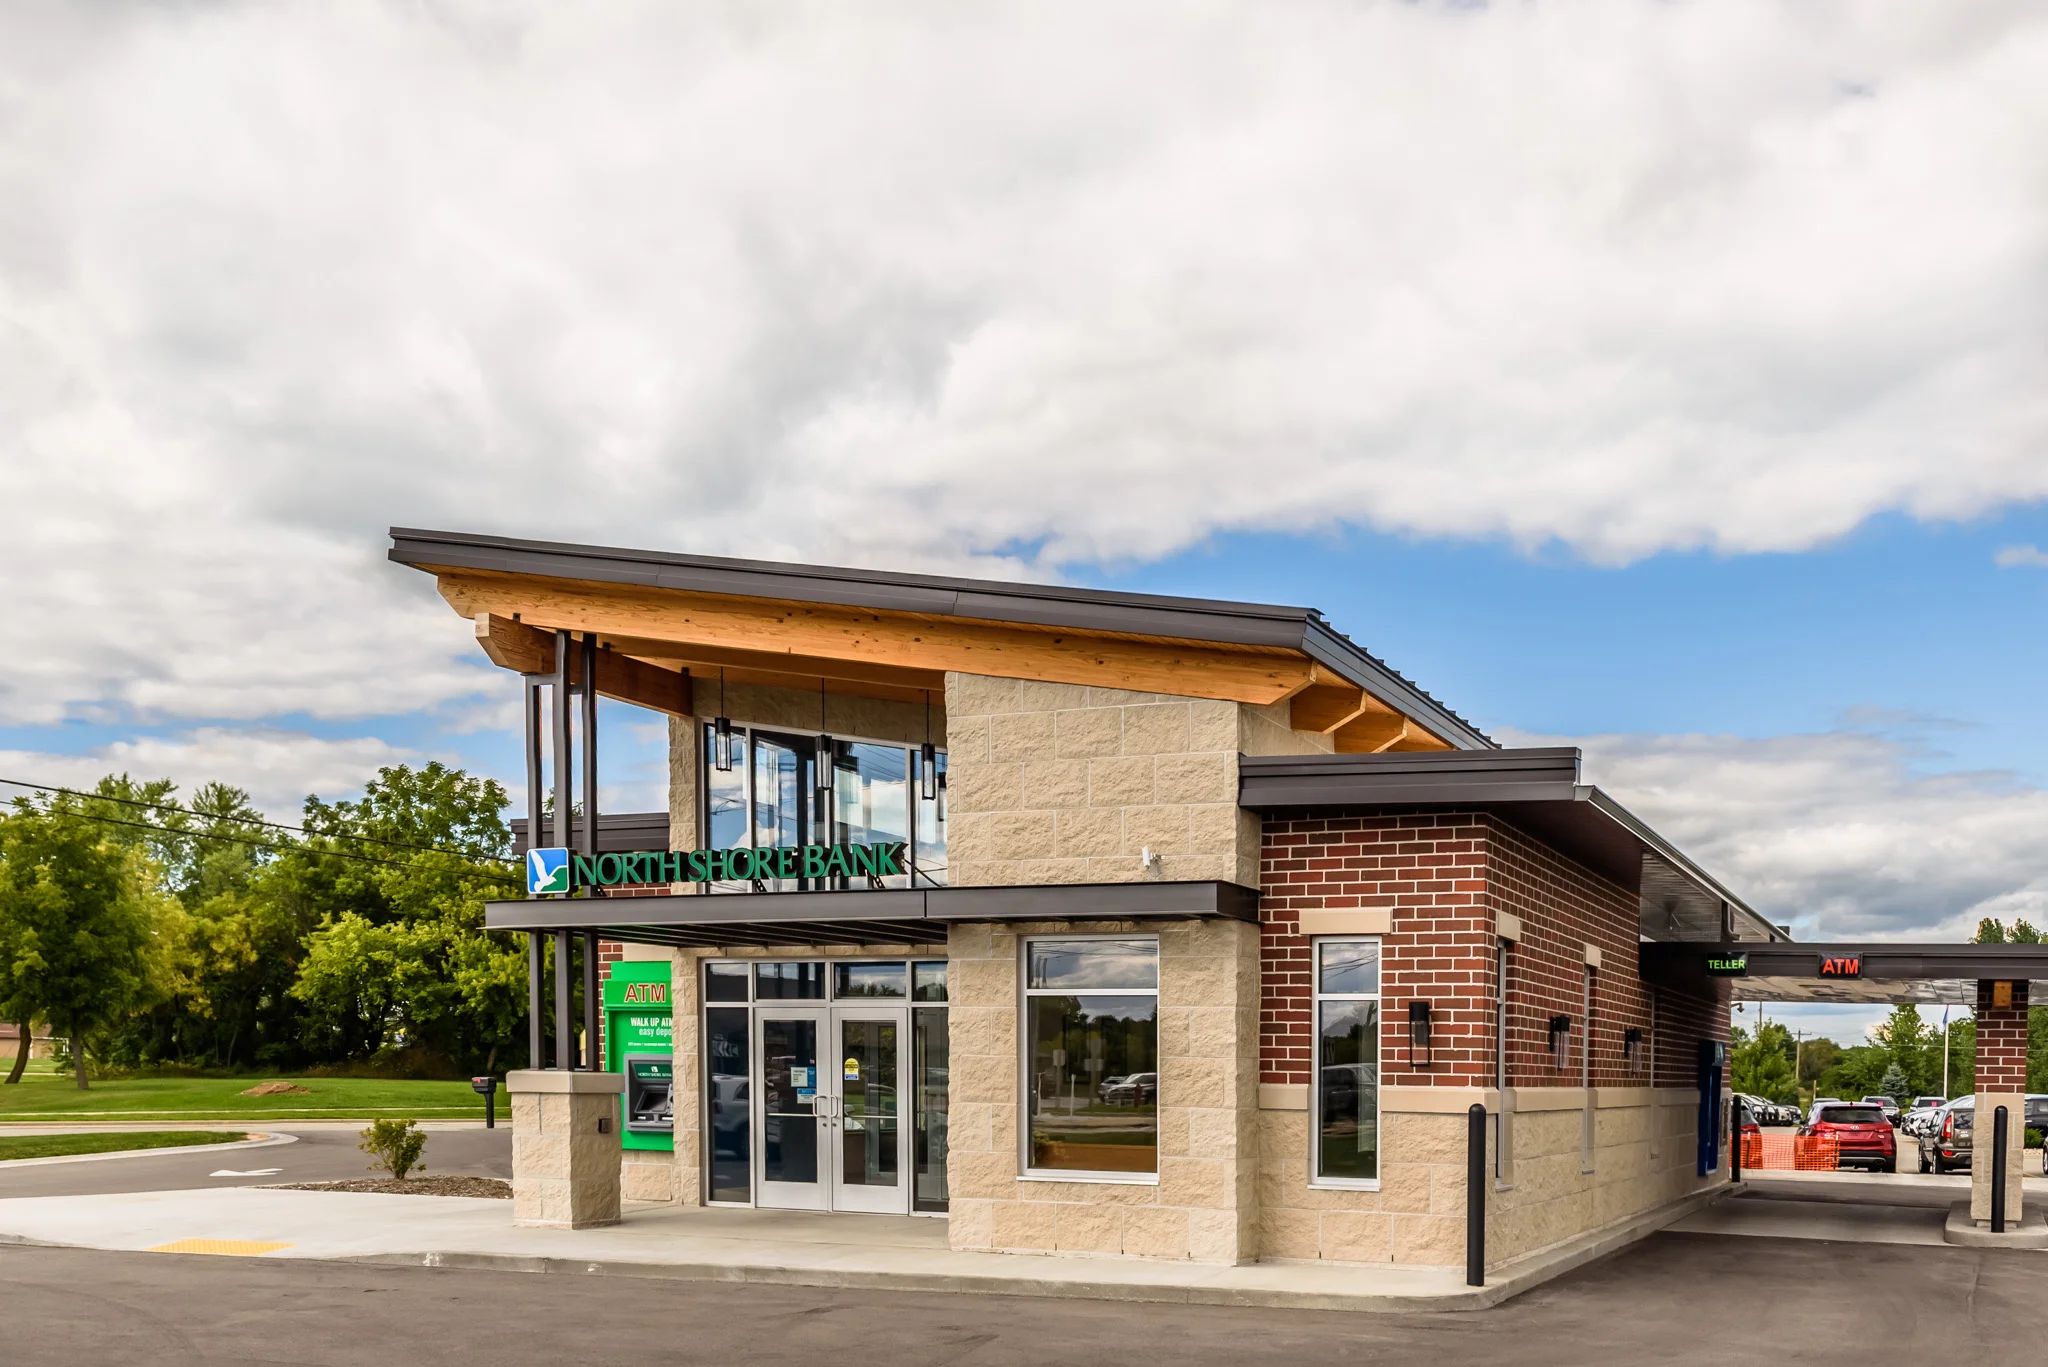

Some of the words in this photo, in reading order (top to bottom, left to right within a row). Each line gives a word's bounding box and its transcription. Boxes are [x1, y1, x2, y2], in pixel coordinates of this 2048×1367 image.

[573, 850, 681, 886] NORTH
[687, 846, 798, 883] SHORE
[803, 842, 903, 879] BANK
[1708, 959, 1745, 969] TELLER
[1822, 958, 1859, 974] ATM
[624, 983, 666, 1003] ATM
[630, 1017, 649, 1026] WALK
[650, 1017, 660, 1026] UP
[639, 1028, 655, 1037] easy
